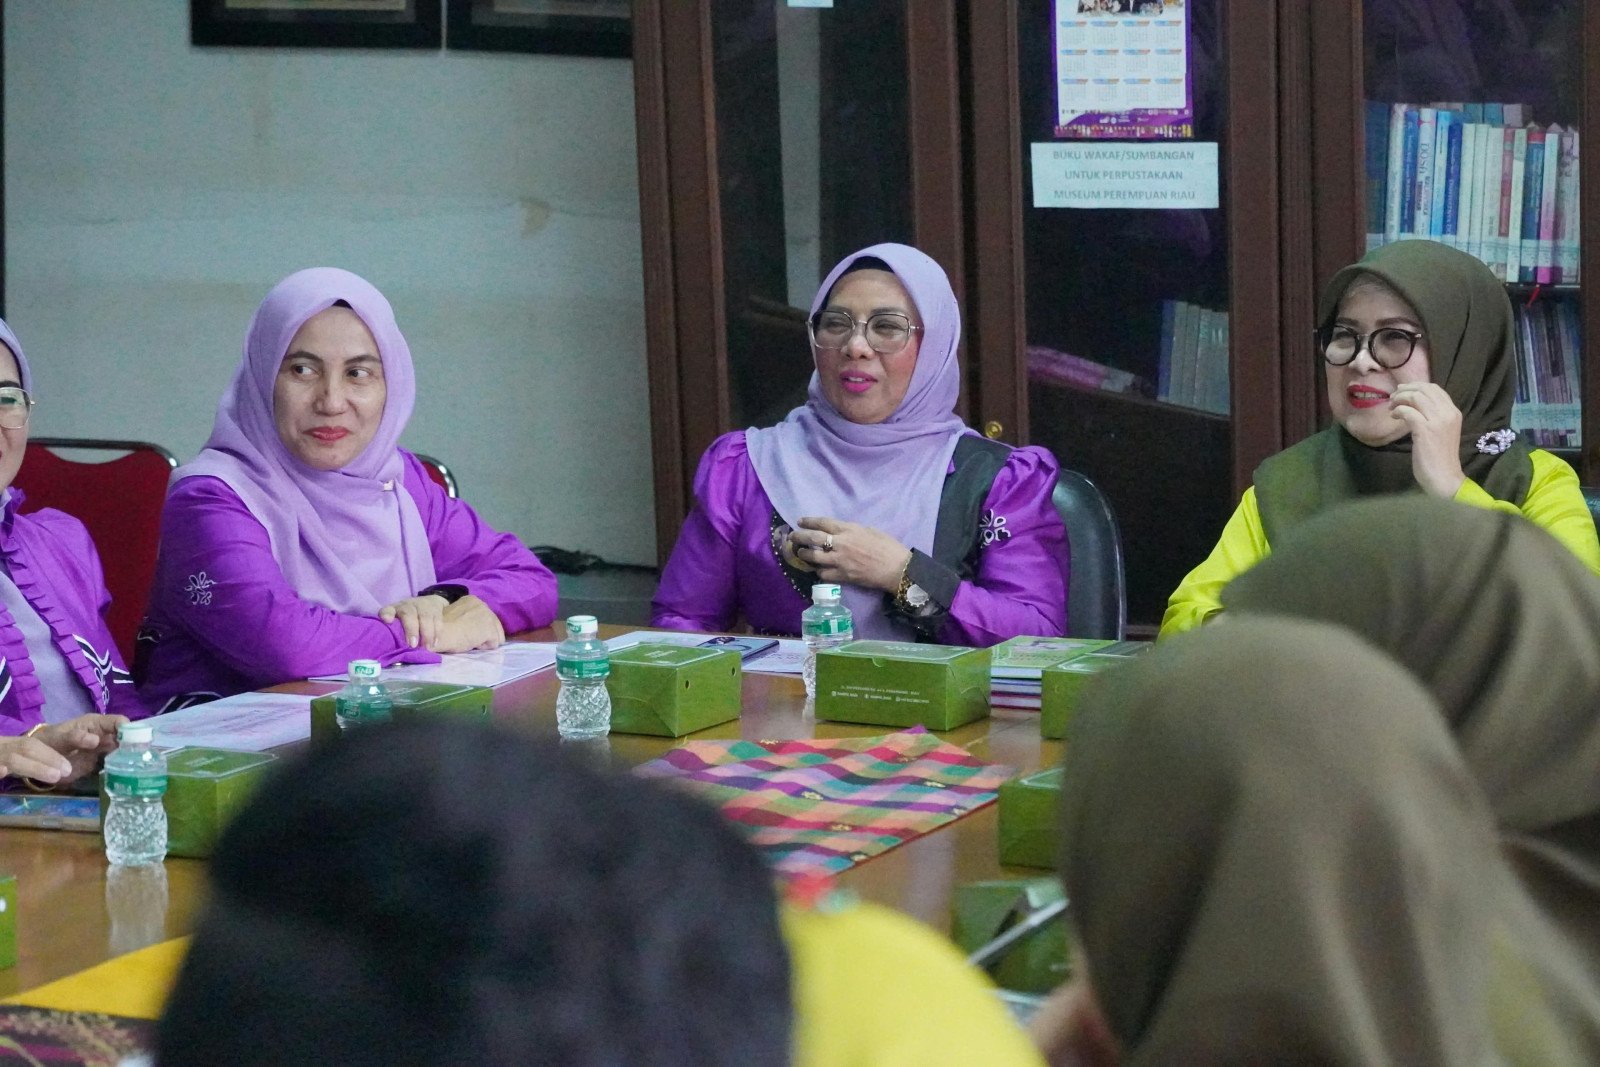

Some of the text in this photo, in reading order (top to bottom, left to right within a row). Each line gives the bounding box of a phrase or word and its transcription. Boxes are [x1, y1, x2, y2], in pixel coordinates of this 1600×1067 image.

[1053, 150, 1195, 161] BUKU WAKAF/SUMBANGAN
[1064, 170, 1183, 180] UNTUK PERPUSTAKAAN
[1053, 189, 1196, 201] MUSEUM PEREMPUAN RIAU
